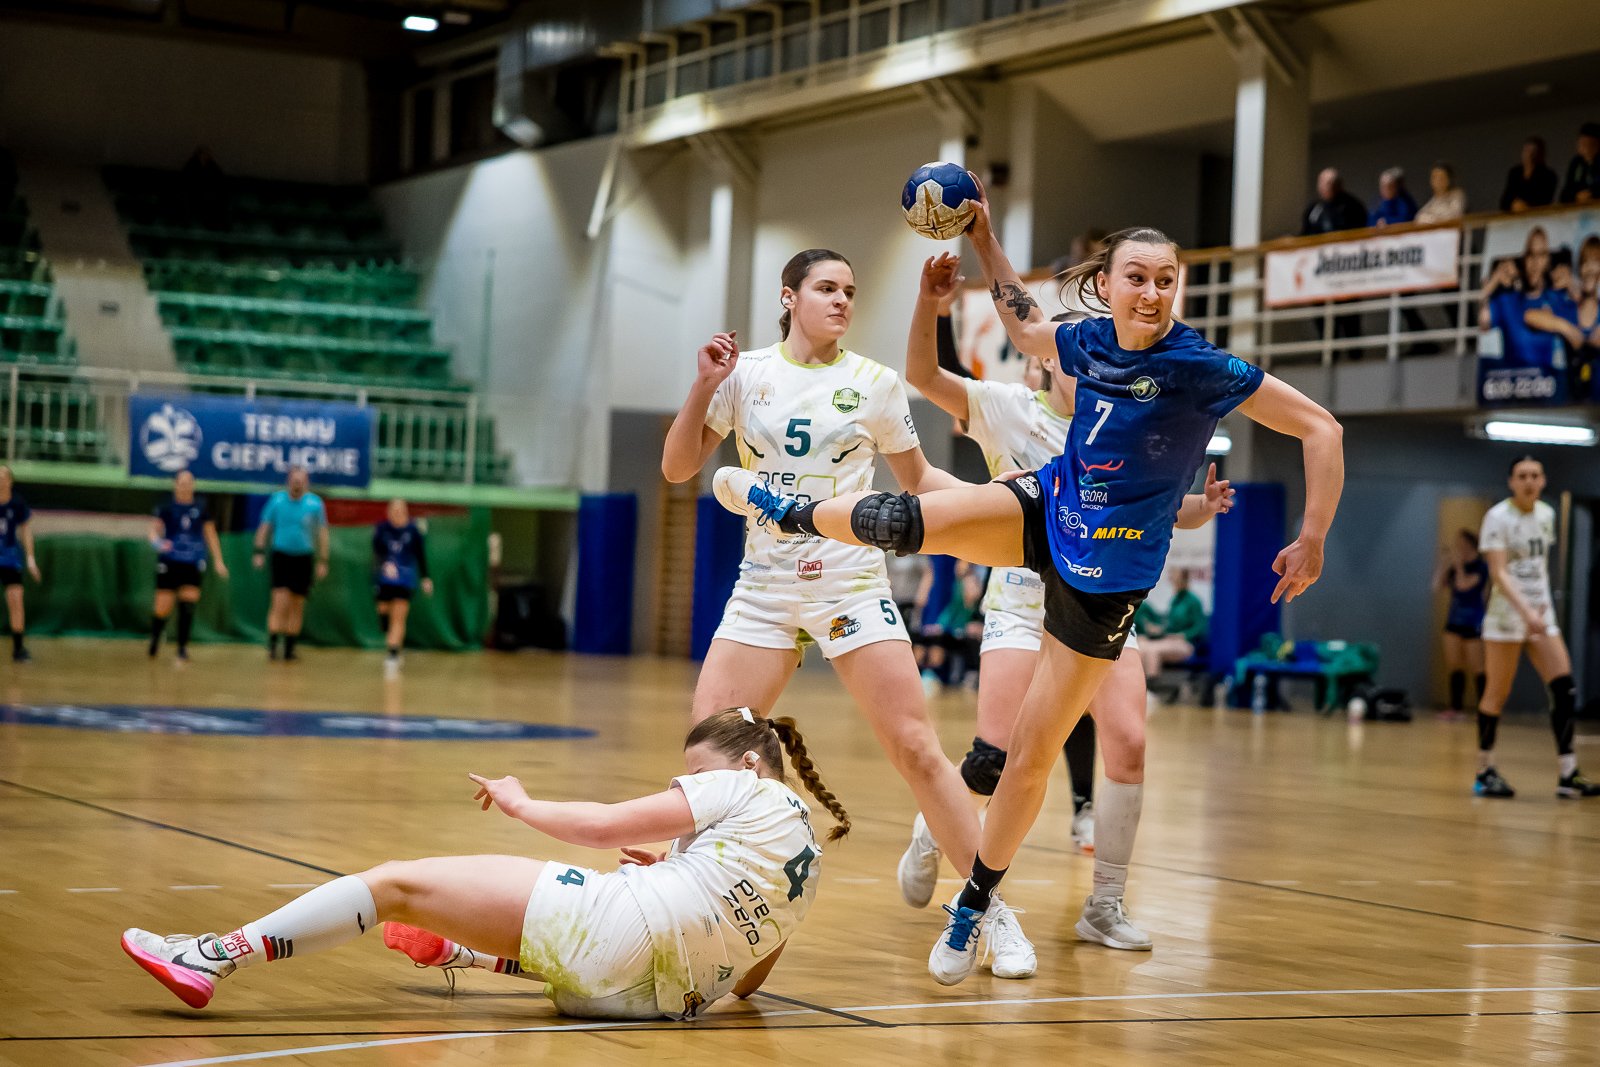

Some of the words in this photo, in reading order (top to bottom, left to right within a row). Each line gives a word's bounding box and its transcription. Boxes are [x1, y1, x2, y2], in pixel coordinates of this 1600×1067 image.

[244, 414, 336, 443] TERMY
[785, 418, 812, 458] 5
[1085, 400, 1114, 445] 7
[211, 443, 359, 474] CIEPLICKIE
[1092, 527, 1145, 540] MATEX
[879, 599, 897, 626] 5
[1117, 603, 1135, 628] 7
[556, 868, 585, 886] 4
[783, 845, 815, 902] 4
[734, 879, 770, 919] pre
[723, 889, 760, 946] zero
